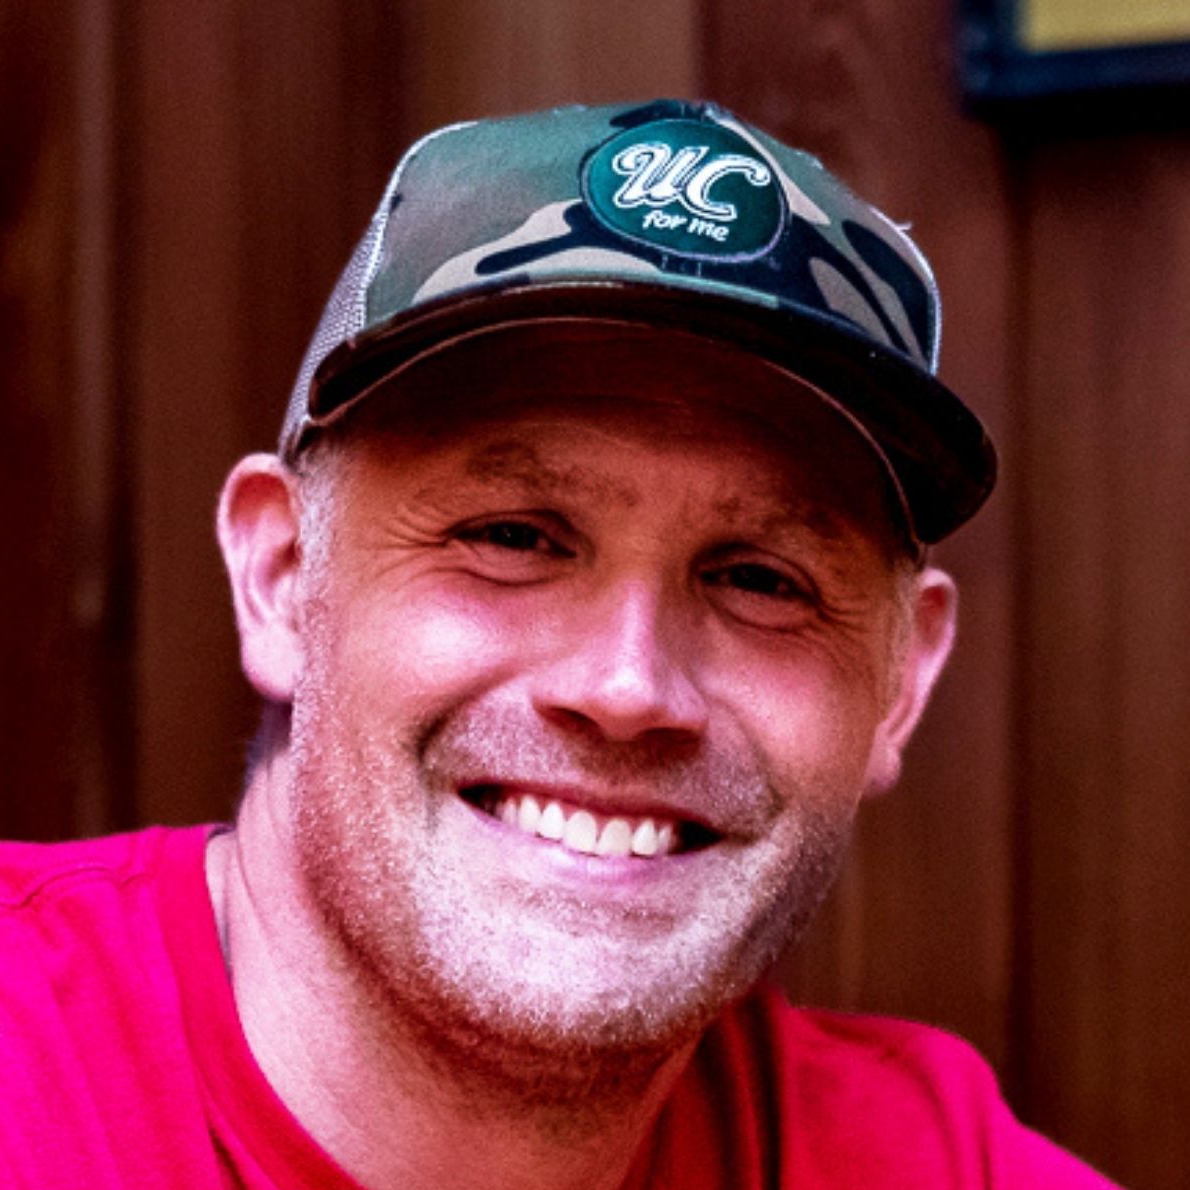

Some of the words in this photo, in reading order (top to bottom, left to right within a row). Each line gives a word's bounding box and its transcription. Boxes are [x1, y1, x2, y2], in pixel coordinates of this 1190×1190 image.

[612, 142, 771, 221] UC
[642, 210, 687, 230] for
[688, 217, 730, 242] me
